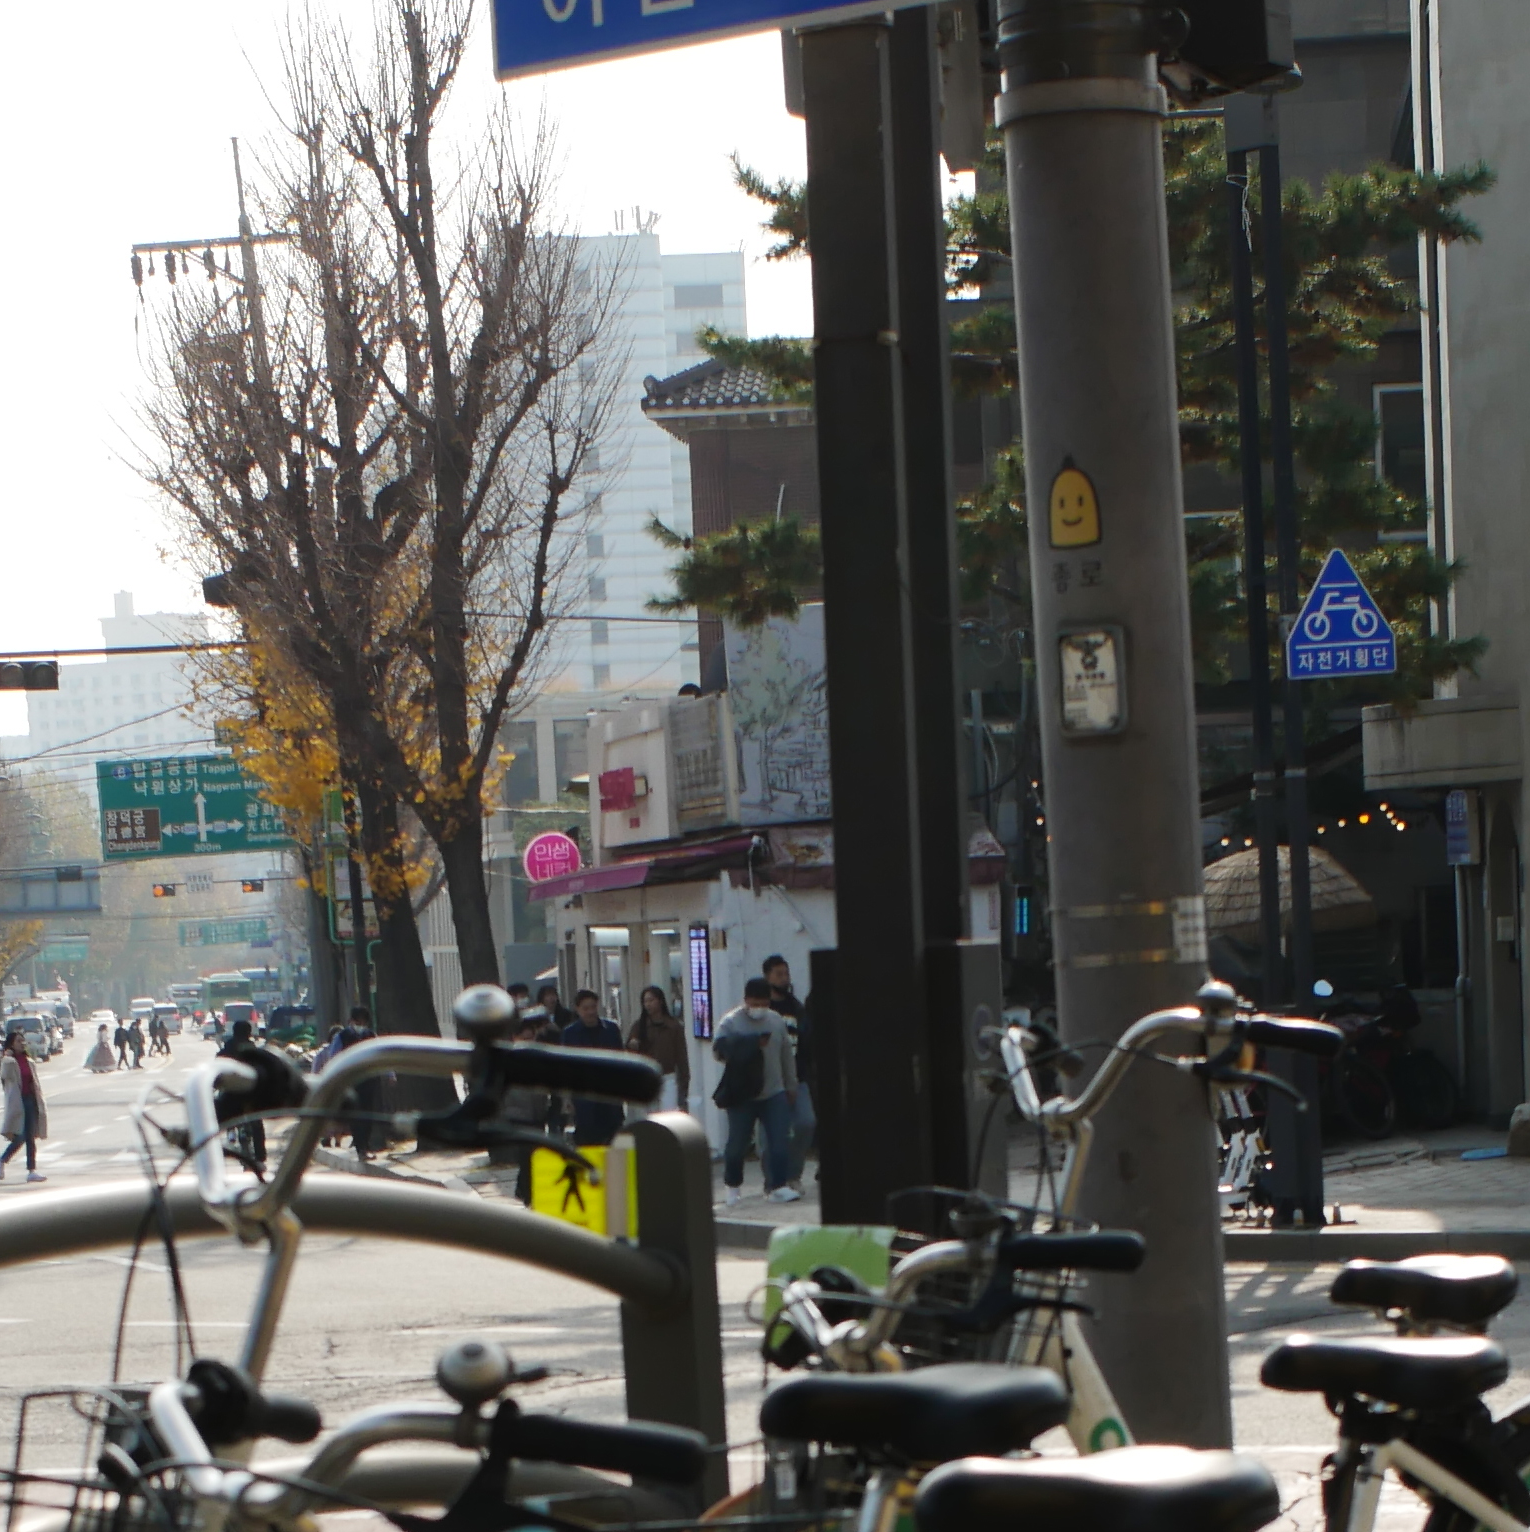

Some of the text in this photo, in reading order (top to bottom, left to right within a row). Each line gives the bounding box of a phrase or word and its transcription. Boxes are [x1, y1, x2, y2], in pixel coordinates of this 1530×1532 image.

[1298, 646, 1388, 672] 자전거횡단
[134, 777, 199, 797] 낙원상가
[202, 782, 241, 794] Nagwon
[534, 841, 570, 862] 인생
